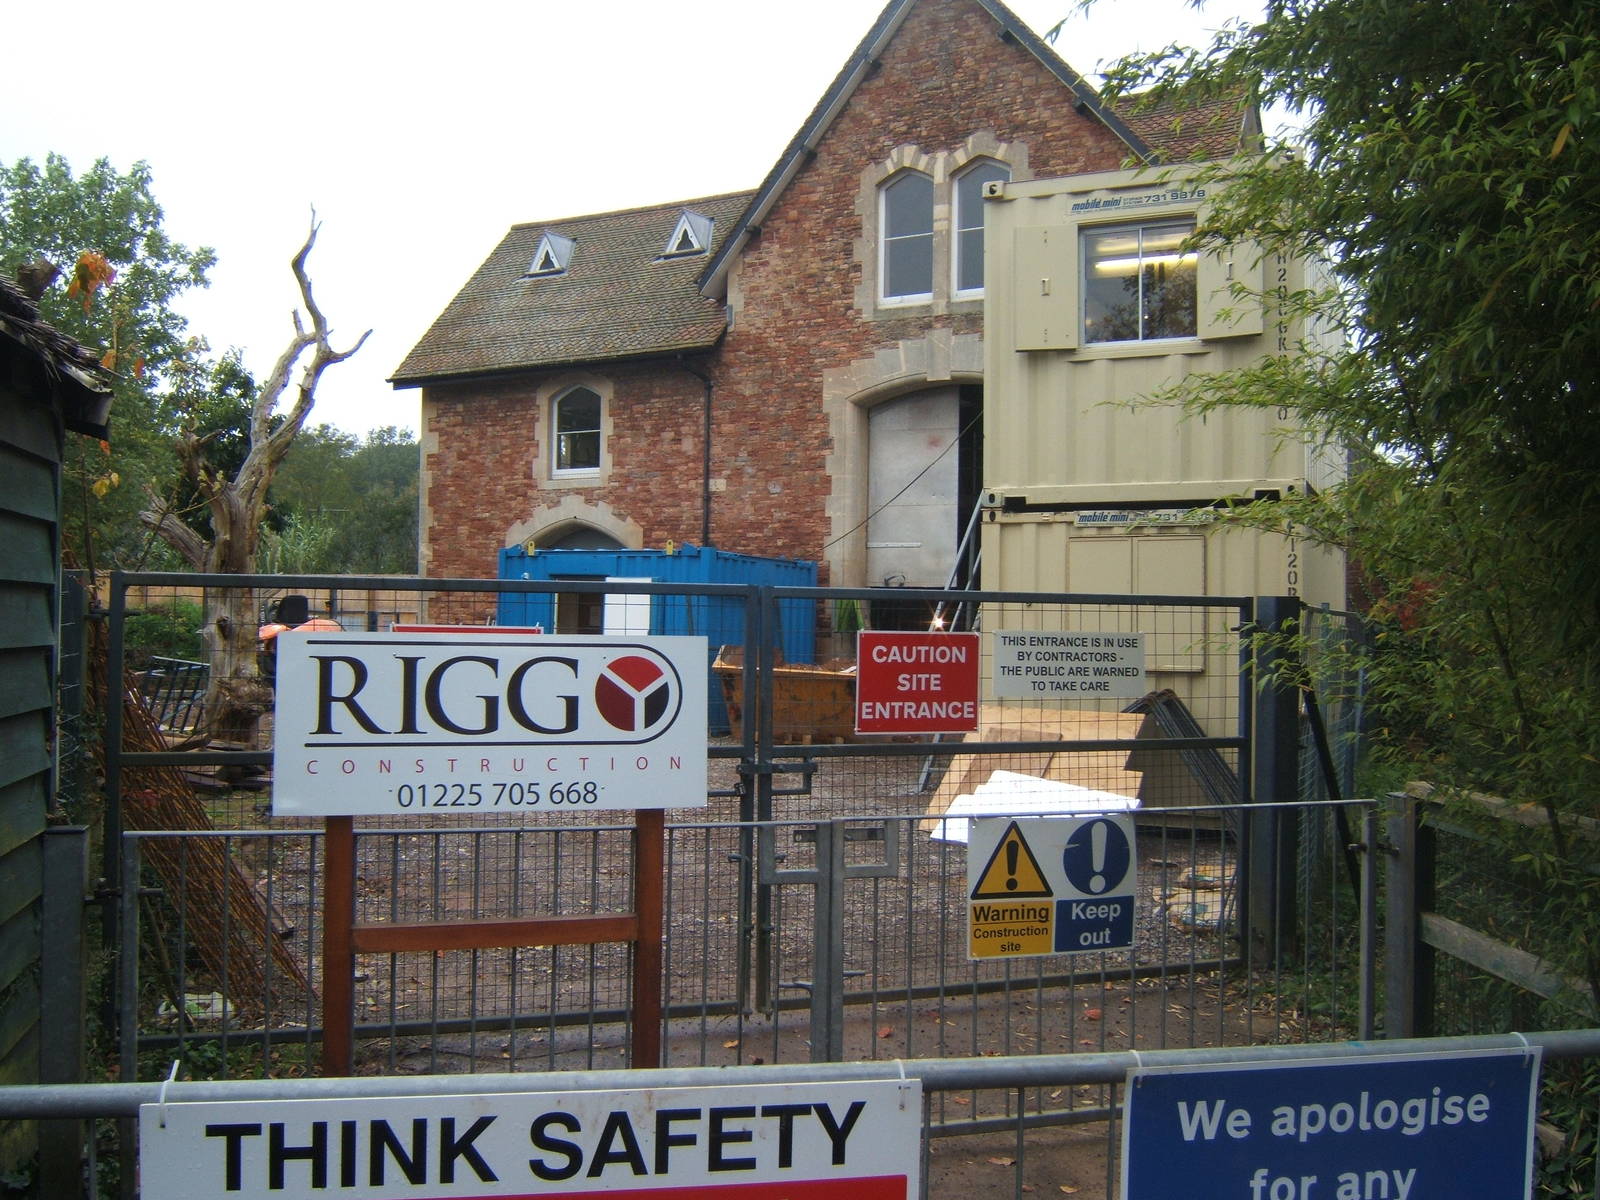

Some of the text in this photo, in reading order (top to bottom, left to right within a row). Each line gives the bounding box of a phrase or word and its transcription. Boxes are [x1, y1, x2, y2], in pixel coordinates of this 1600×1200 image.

[1071, 197, 1101, 211] mobile
[1102, 196, 1122, 208] mini
[1144, 193, 1167, 203] 731
[1078, 511, 1107, 523] mobile
[1110, 511, 1129, 523] mini
[1001, 635, 1138, 648] THIS ENTRANCE IS IN USE
[871, 645, 967, 664] CAUTION
[1016, 651, 1034, 662] BY
[1035, 651, 1117, 662] CONTRACTORS
[1001, 665, 1139, 678] THE PUBLIC ARE WARNED
[896, 673, 941, 692] SITE
[1031, 680, 1110, 692] TO TAKE CARE
[861, 700, 976, 720] ENTRANCE
[306, 756, 682, 775] CONSTRUCTION
[397, 781, 598, 808] 01225 705 668
[972, 904, 1049, 923] Warning
[1071, 902, 1121, 922] Keep
[973, 926, 1048, 939] Construction
[1079, 927, 1111, 946] out
[1000, 941, 1021, 952] site
[1177, 1086, 1491, 1143] We apologise
[205, 1100, 866, 1192] THINK SAFETY
[1249, 1168, 1417, 1200] for any
